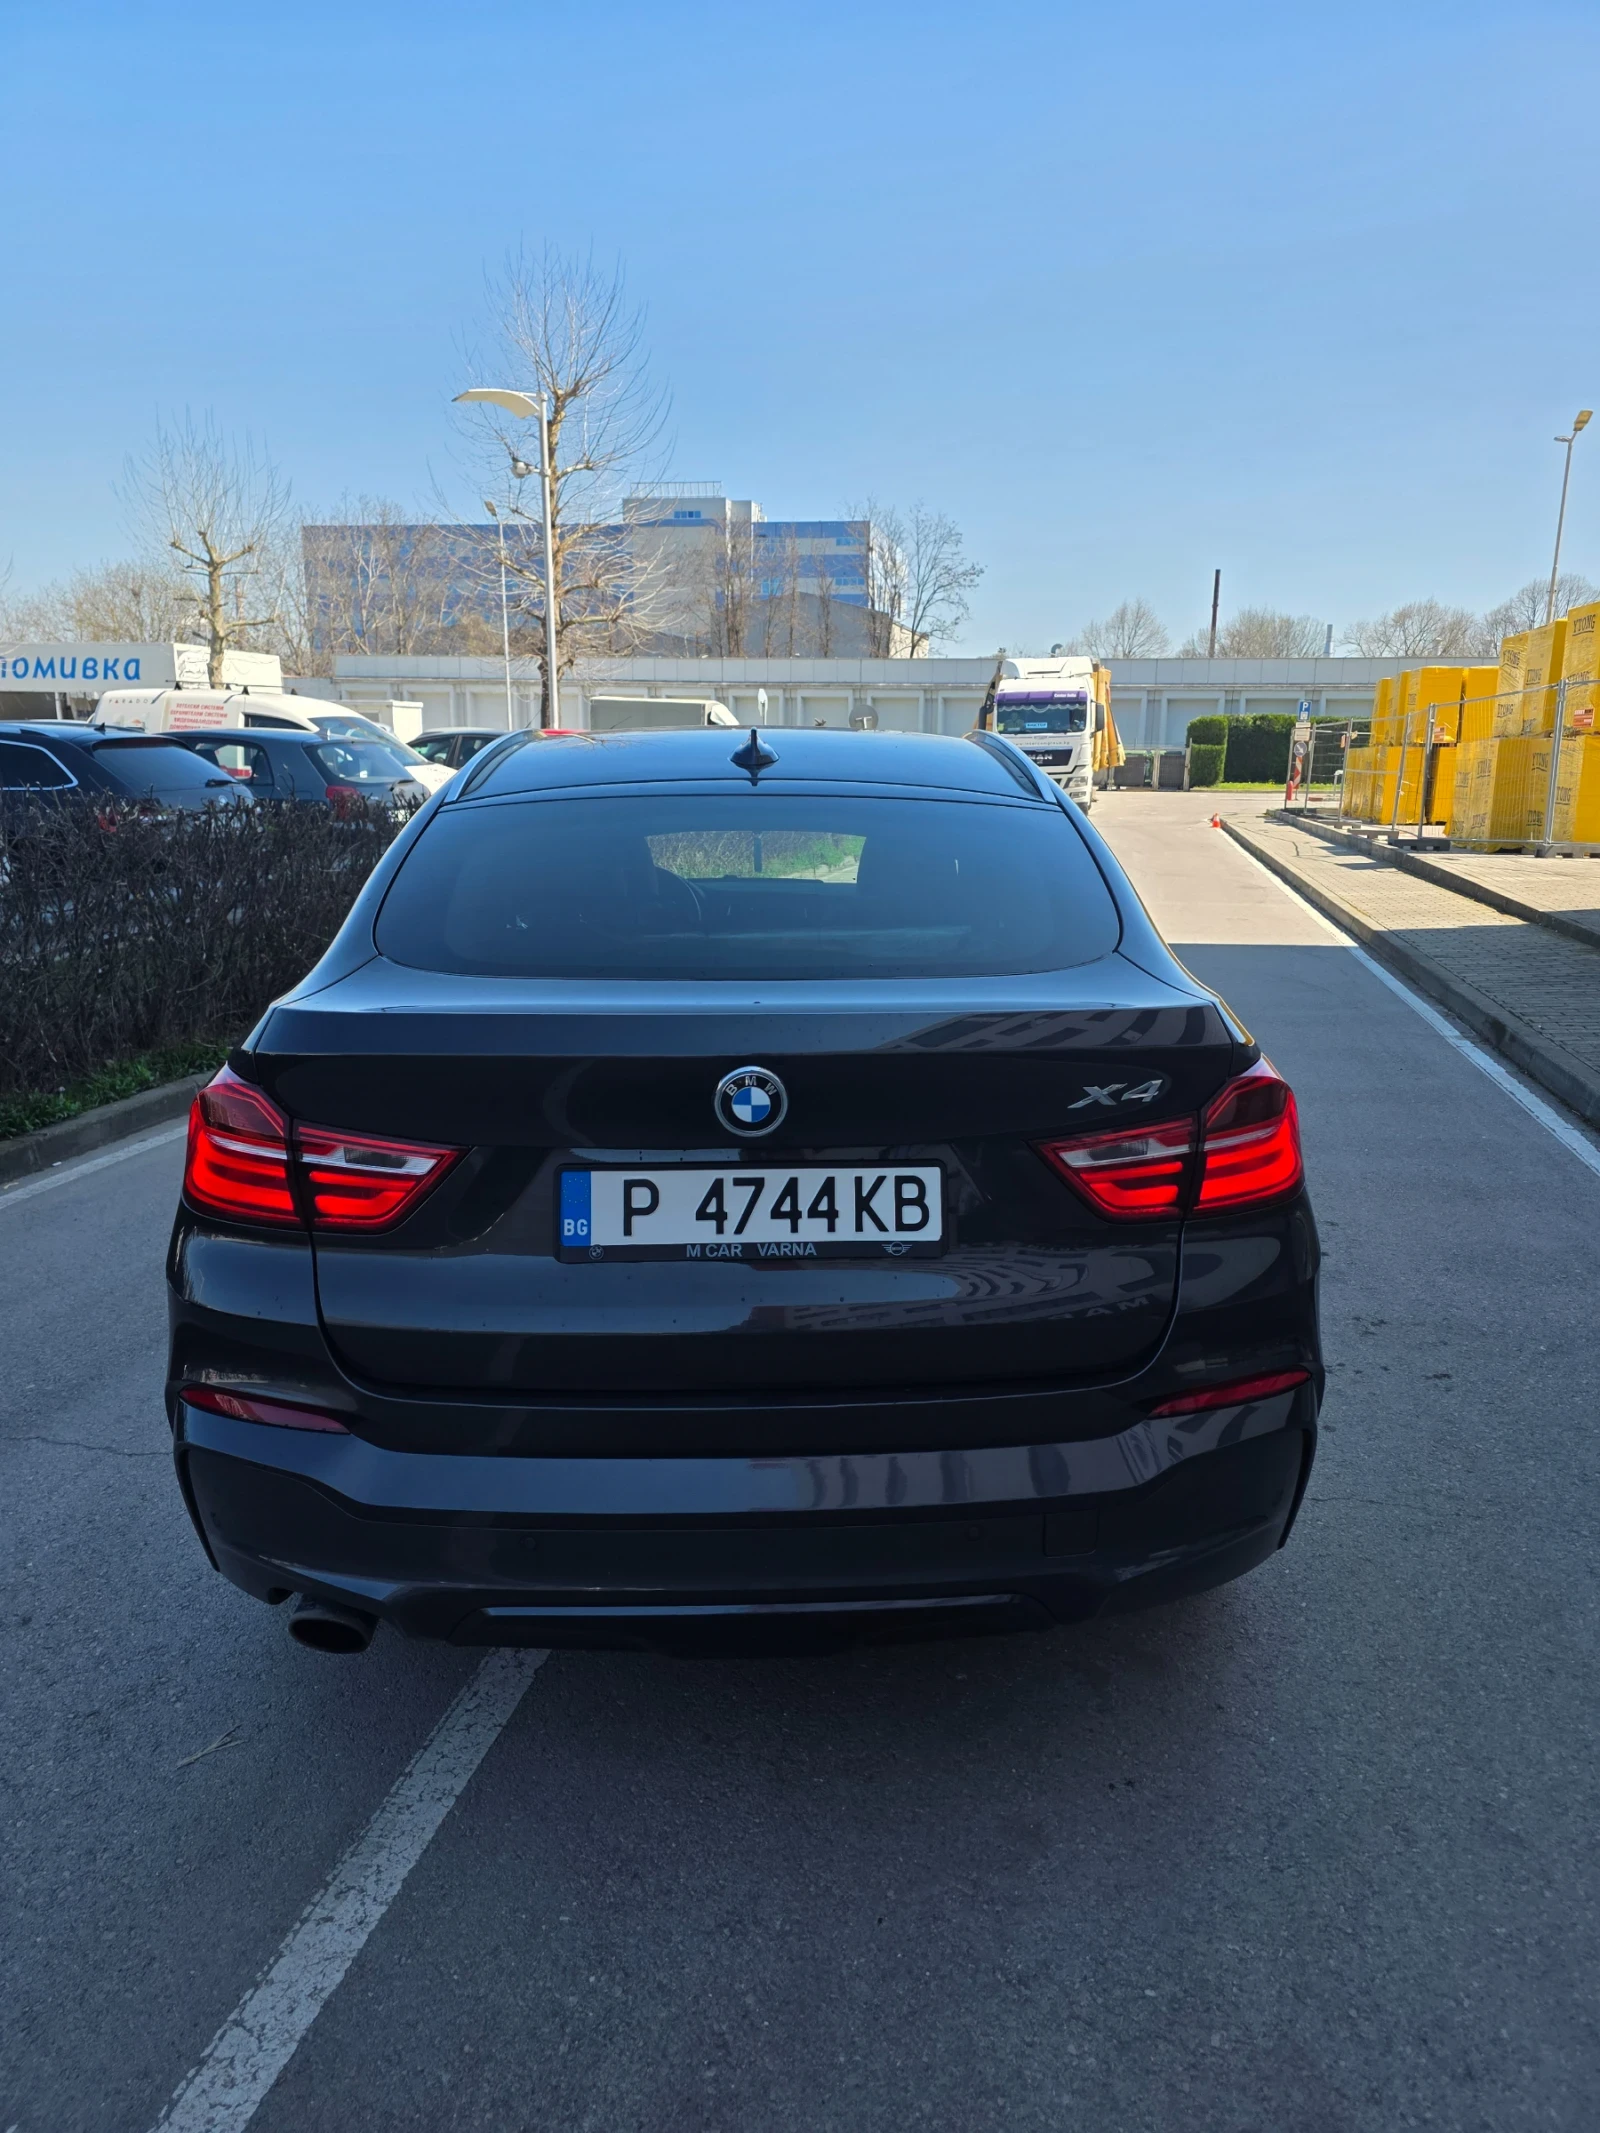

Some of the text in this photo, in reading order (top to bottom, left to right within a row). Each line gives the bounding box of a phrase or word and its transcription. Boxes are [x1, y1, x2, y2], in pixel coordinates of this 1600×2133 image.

[1573, 614, 1596, 633] YTONG
[1303, 702, 1309, 711] P
[725, 1075, 778, 1097] BMW
[1067, 1079, 1163, 1109] X4
[623, 1178, 660, 1237] P
[563, 1219, 588, 1236] BG
[686, 1242, 817, 1258] M CAR VARNA
